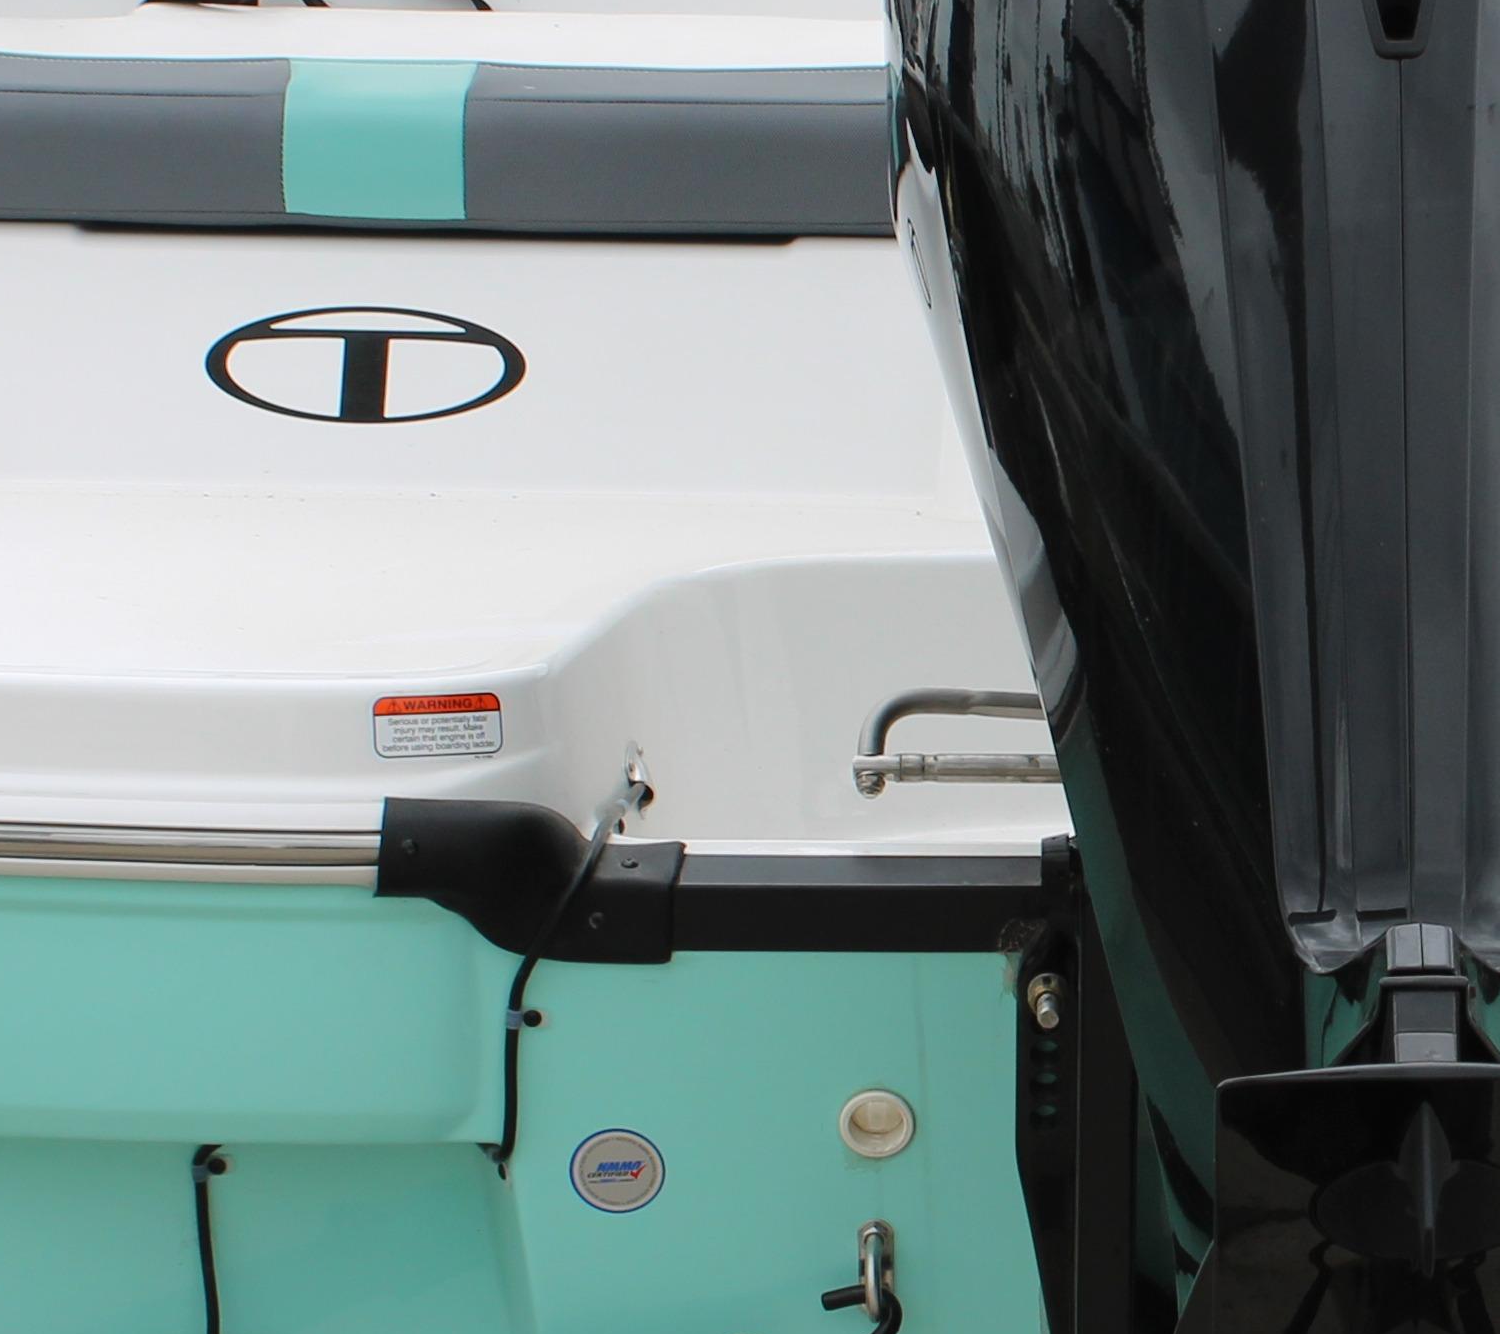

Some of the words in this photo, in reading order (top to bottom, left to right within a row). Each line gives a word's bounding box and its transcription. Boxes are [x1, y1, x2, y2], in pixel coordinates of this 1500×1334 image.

[404, 698, 473, 710] WARNING
[388, 717, 418, 726] Serious
[431, 715, 470, 725] potentially
[393, 727, 416, 736] injury
[463, 723, 483, 731] Make
[392, 735, 420, 743] certain
[440, 733, 466, 742] engine
[383, 744, 408, 752] before
[411, 743, 433, 753] using
[436, 741, 470, 751] boarding
[587, 1171, 629, 1179] CERTIFIED
